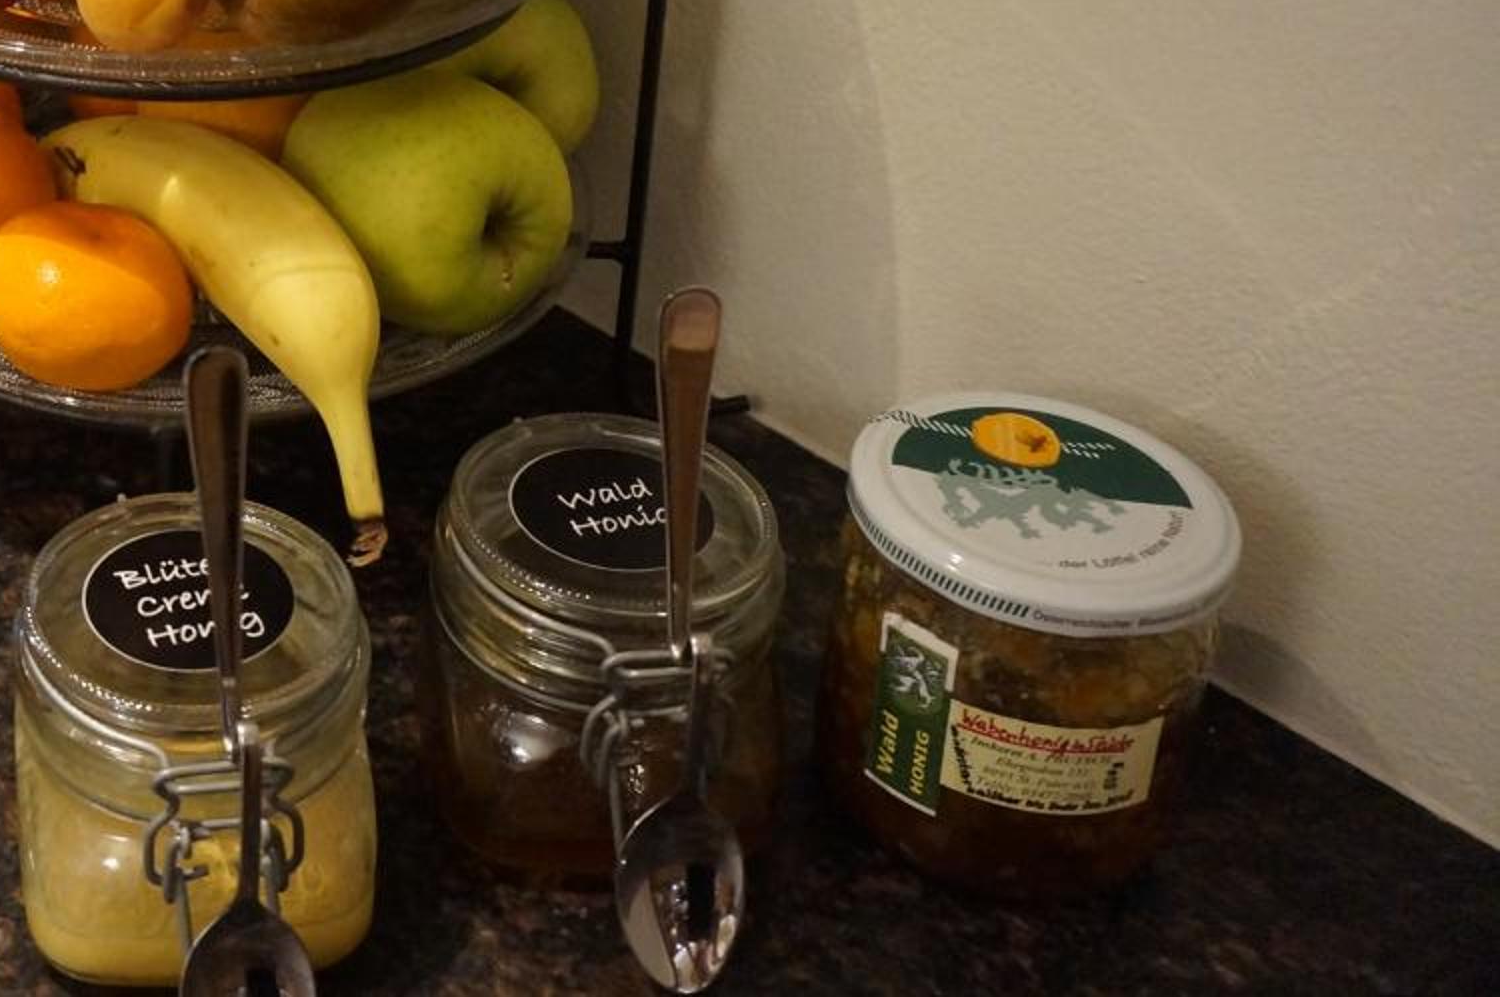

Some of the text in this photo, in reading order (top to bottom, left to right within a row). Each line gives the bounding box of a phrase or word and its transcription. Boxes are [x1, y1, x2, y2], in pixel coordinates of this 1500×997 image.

[557, 477, 653, 510] Wald
[112, 558, 213, 590] Blüte
[137, 583, 250, 617] Cre
[146, 611, 265, 648] Hong
[876, 709, 899, 774] Wald
[909, 730, 930, 795] HONIG
